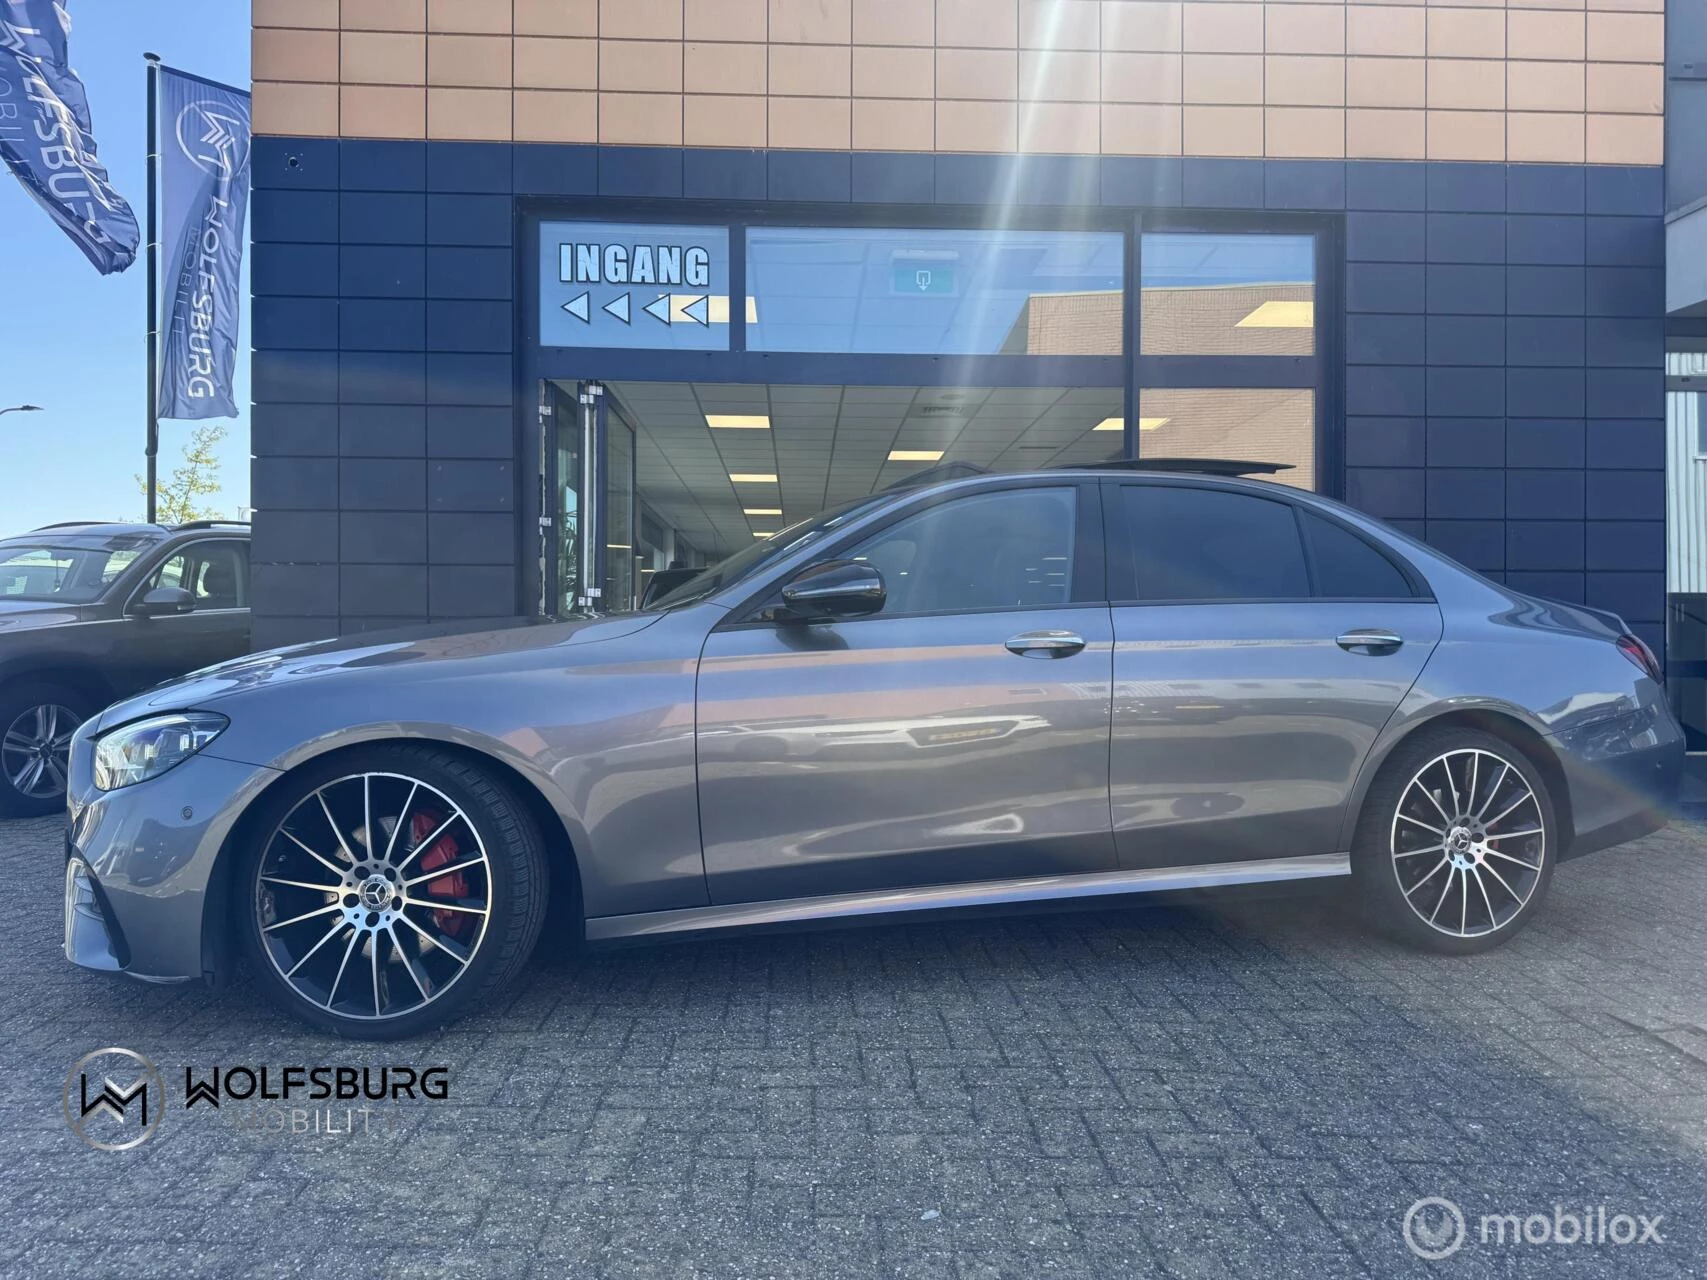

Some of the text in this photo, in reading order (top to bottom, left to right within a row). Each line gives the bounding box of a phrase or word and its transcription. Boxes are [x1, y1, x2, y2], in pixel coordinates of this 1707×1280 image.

[172, 226, 201, 338] MOBILIT
[187, 195, 228, 398] WOLFSBURG
[558, 243, 710, 287] INGANG
